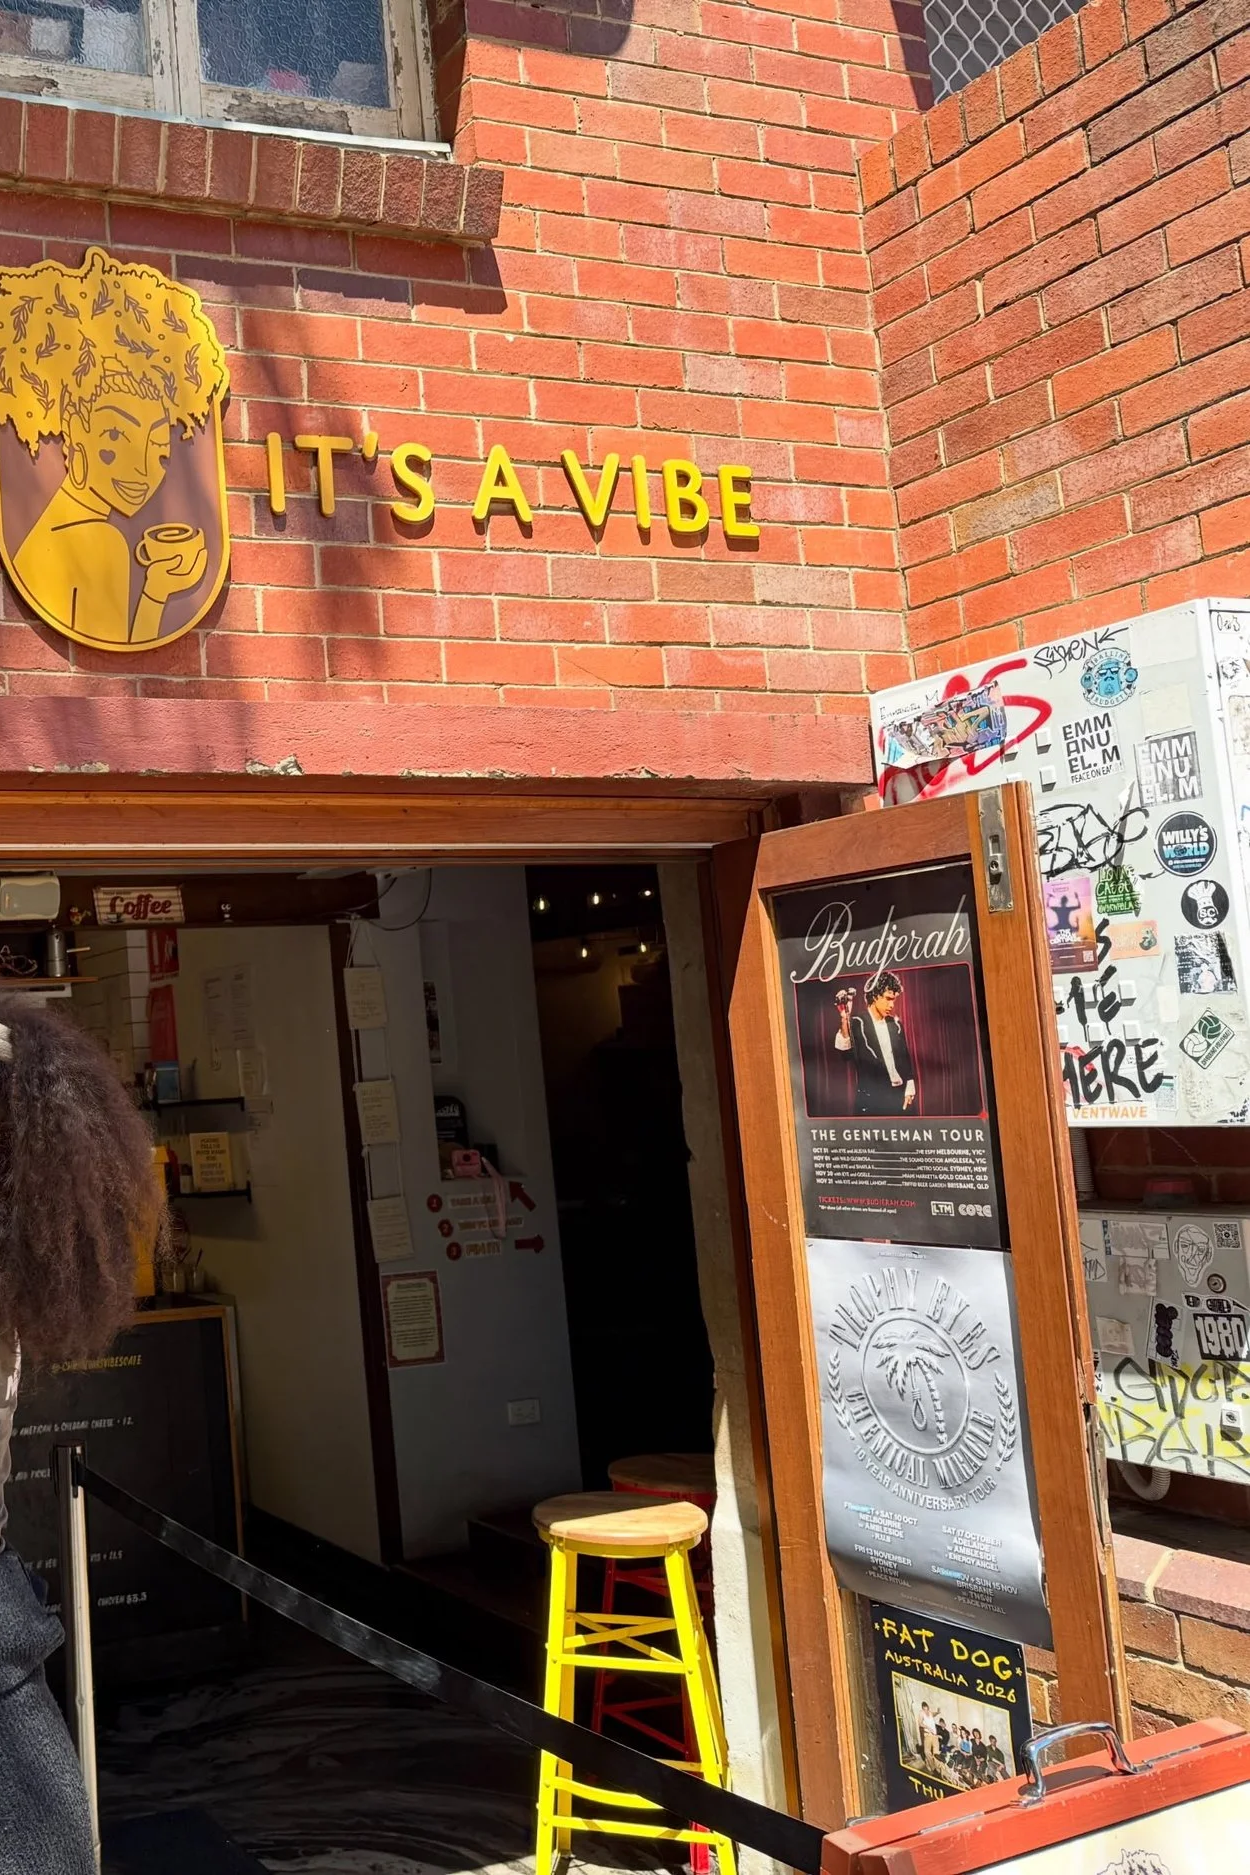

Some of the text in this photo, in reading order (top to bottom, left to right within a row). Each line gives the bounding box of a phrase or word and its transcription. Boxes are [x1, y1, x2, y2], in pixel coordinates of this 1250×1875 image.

[266, 431, 435, 525] IT'S
[472, 444, 533, 525] A
[561, 449, 760, 538] VIBE
[1062, 712, 1112, 741] EMM
[1066, 730, 1111, 756] ANU
[1068, 745, 1121, 774] EL. M
[1162, 825, 1209, 844] WILLY'S
[1162, 842, 1210, 858] WORLD
[110, 894, 172, 920] Coffee
[790, 894, 971, 993] Budjerah
[1073, 1105, 1148, 1120] VENTWAVE
[811, 1129, 984, 1142] THE GENTLEMAN TOUR
[933, 1203, 952, 1214] LTM
[925, 1275, 1002, 1370] EYES
[1198, 1316, 1246, 1358] 1980
[846, 1389, 996, 1490] CHEMICAL MIRACLE
[853, 1444, 865, 1461] 10
[865, 1459, 890, 1488] YEAR
[892, 1480, 969, 1511] ANNIVERSARY
[969, 1475, 997, 1502] TOUR
[859, 1513, 902, 1530] MELBOURNE
[880, 1510, 893, 1520] SAT
[902, 1515, 918, 1526] OCT
[942, 1525, 956, 1536] SAT
[966, 1531, 1002, 1548] OCTOBER
[953, 1537, 991, 1553] ADELAIDE
[854, 1543, 866, 1554] FRI
[874, 1549, 912, 1567] NOVEMBER
[870, 1556, 898, 1570] SYDNEY
[949, 1552, 976, 1566] ENERGY
[956, 1580, 994, 1597] BRISBANE
[975, 1577, 991, 1588] SUN
[1001, 1583, 1019, 1595] NOV
[882, 1617, 1012, 1681] FAT DOG
[884, 1650, 1017, 1703] AUSTRALIA 2026
[909, 1775, 944, 1800] THU
